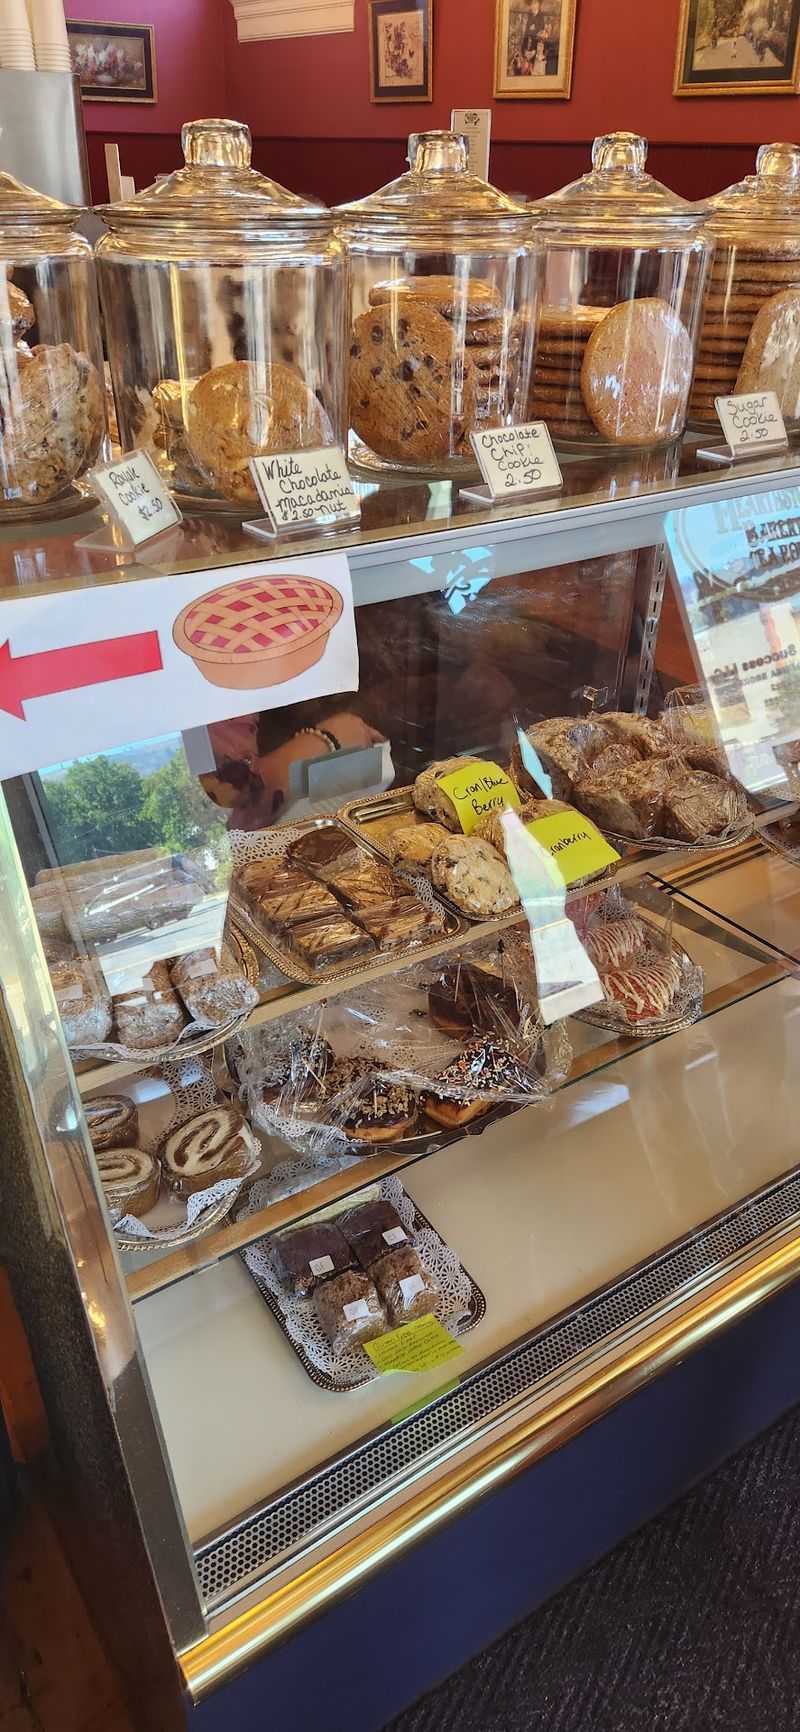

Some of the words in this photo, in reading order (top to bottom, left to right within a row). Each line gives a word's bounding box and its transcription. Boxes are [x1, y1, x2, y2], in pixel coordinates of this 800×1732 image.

[727, 396, 767, 416] Sugar
[732, 412, 778, 429] Cookie
[481, 429, 540, 448] Chocolate
[740, 428, 768, 441] 2.50
[491, 443, 525, 461] Chip
[262, 456, 302, 480] White
[498, 457, 544, 472] Cookie
[279, 464, 342, 494] Chocolate
[504, 469, 542, 487] 2.50
[119, 482, 150, 506] Cookie
[137, 497, 163, 521] $2.50
[453, 776, 509, 800] Cran/Blue
[471, 796, 505, 816] Berry
[551, 831, 592, 856] ranberry
